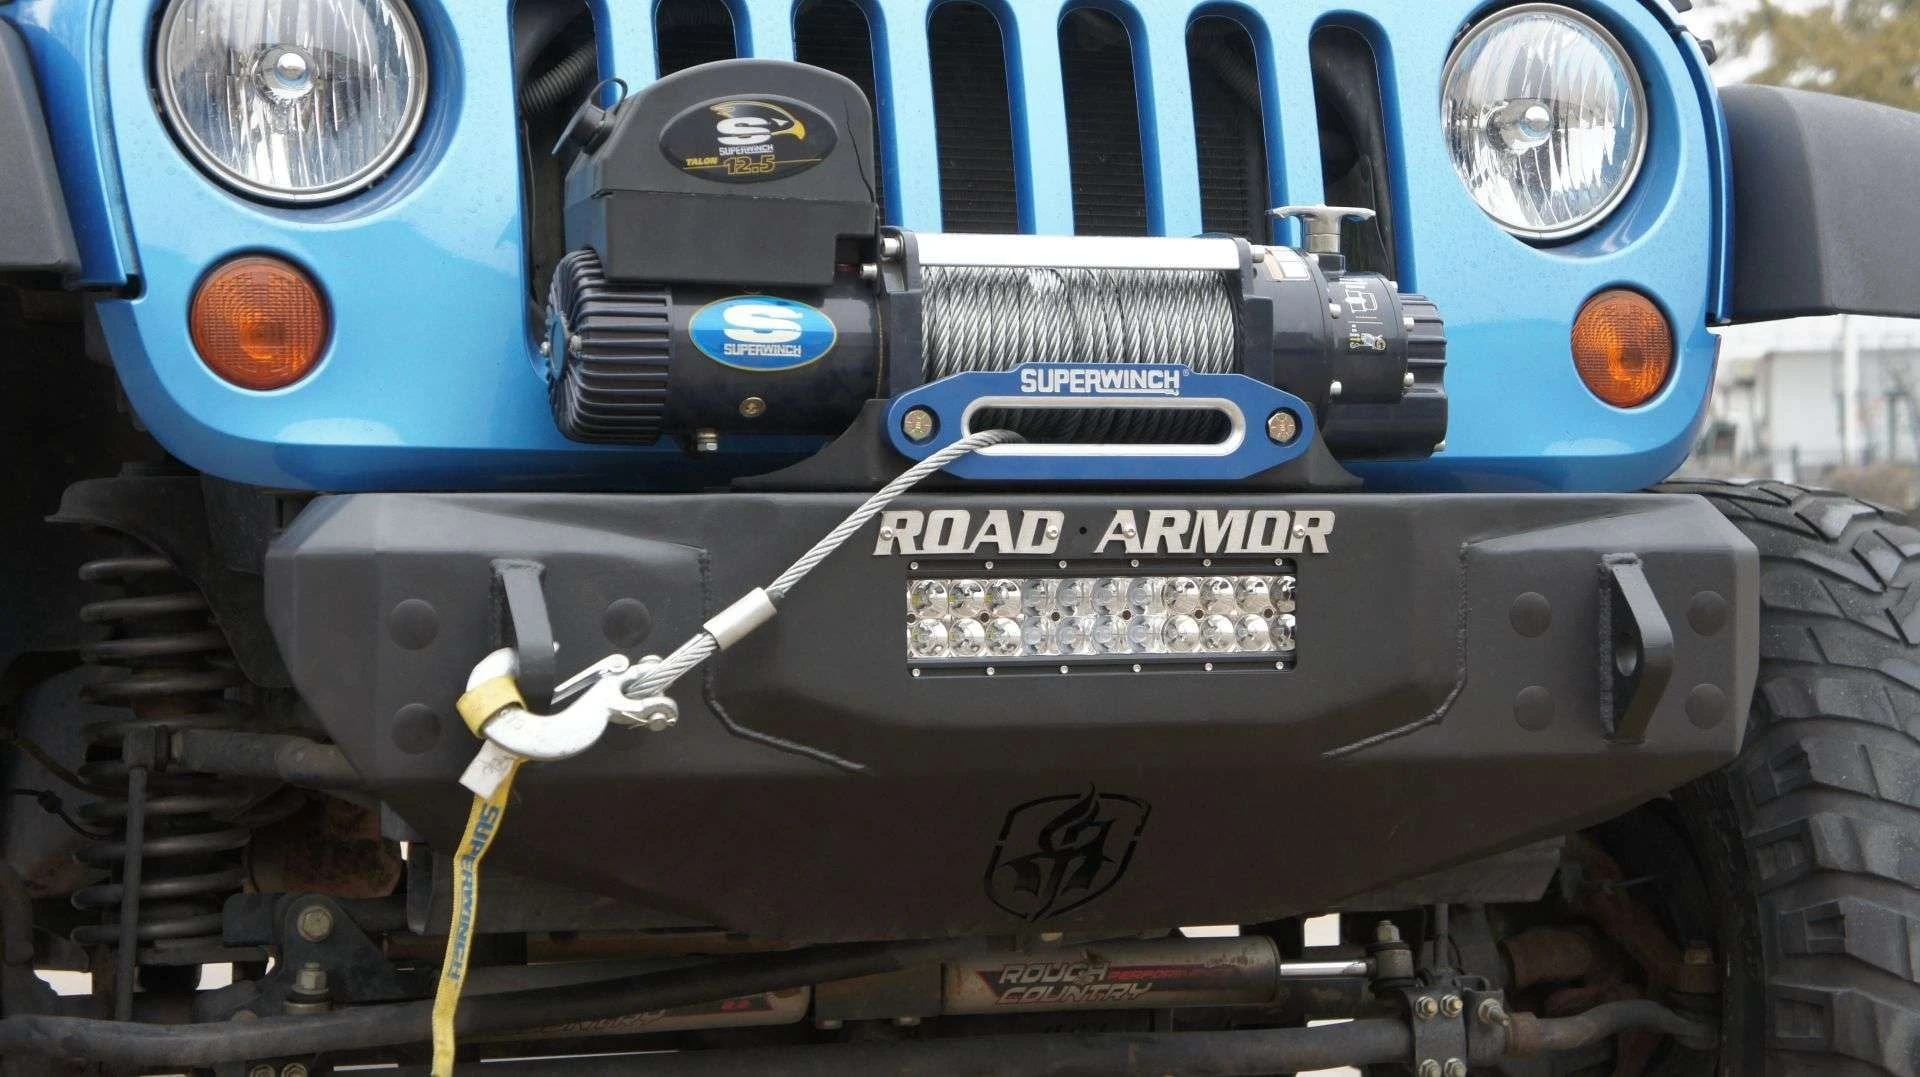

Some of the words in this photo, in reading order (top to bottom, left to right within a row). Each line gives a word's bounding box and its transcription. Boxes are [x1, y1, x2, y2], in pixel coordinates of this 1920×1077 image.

[719, 144, 774, 155] SUPERWINCH
[686, 157, 718, 167] TALON
[724, 155, 775, 174] 12.5
[723, 343, 801, 357] SUPERWINCH
[1020, 368, 1179, 396] SUPERWINCH
[873, 509, 1065, 556] ROAD
[1093, 509, 1336, 554] ARMOR
[1000, 981, 1152, 1003] COUNTRY
